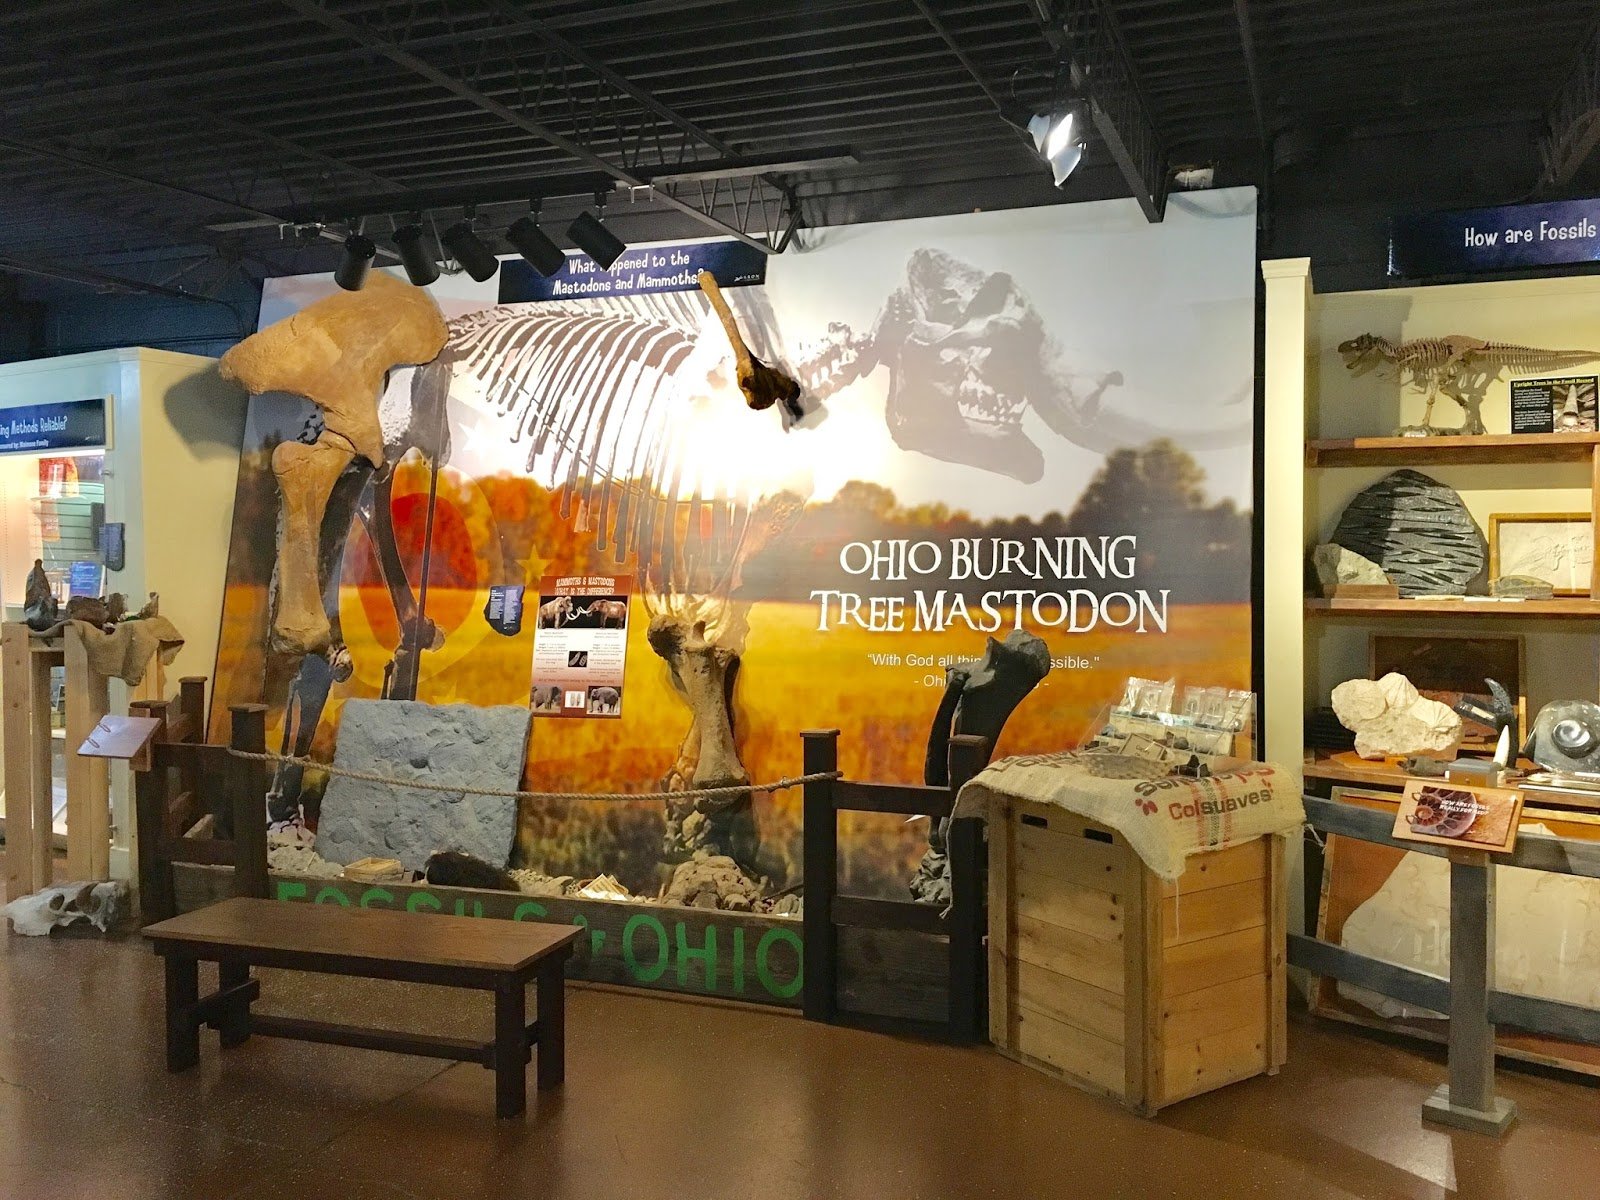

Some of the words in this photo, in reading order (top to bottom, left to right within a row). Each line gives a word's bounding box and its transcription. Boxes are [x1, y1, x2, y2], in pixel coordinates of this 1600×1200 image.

[1465, 227, 1498, 247] How
[1505, 228, 1533, 243] are
[1540, 217, 1596, 241] Fossils
[569, 258, 596, 275] What
[652, 255, 666, 267] to
[671, 250, 690, 265] the
[552, 277, 611, 295] Mastodons
[615, 274, 634, 290] and
[637, 267, 704, 289] Mammoths?
[11, 418, 38, 435] Methods
[40, 415, 67, 432] Reliable?
[839, 539, 942, 581] OHIO
[949, 536, 1137, 581] BURNING
[810, 590, 905, 632] TREE
[912, 589, 1171, 634] MASTODON
[905, 653, 934, 667] God
[938, 655, 953, 667] all
[923, 674, 946, 687] Ohi
[622, 913, 804, 999] OHIO
